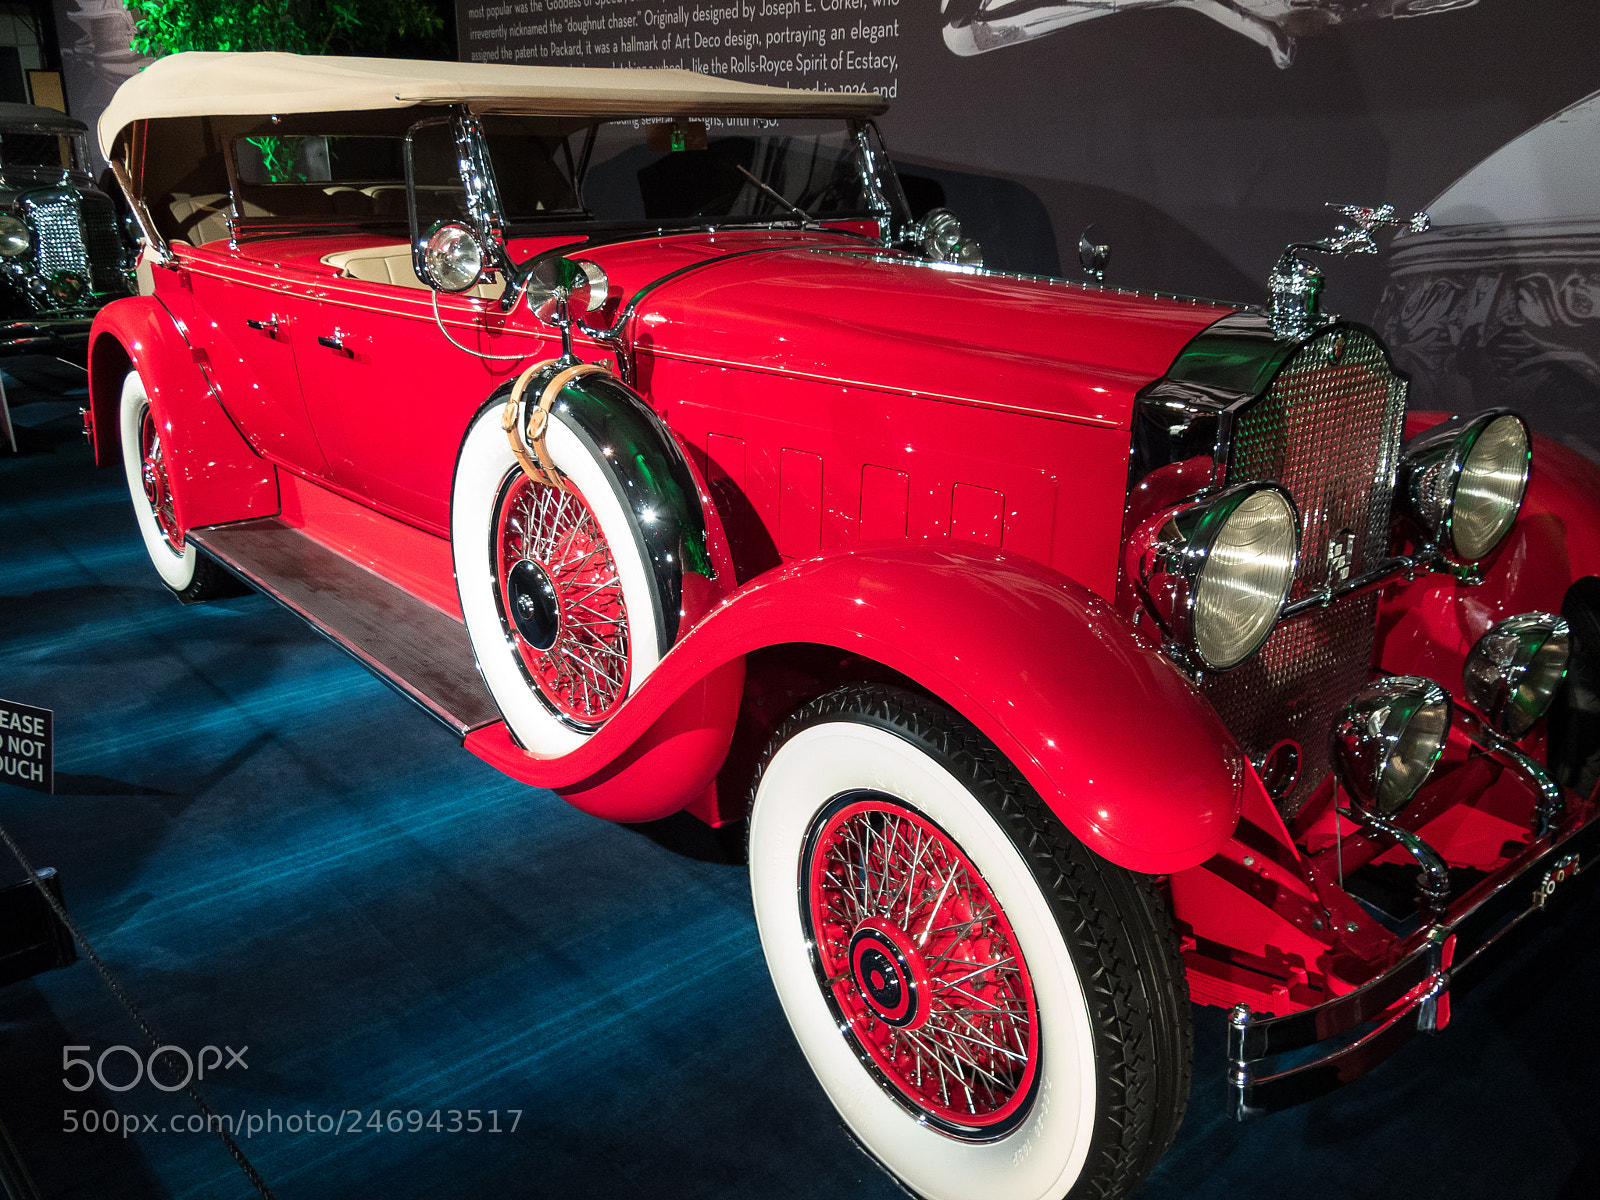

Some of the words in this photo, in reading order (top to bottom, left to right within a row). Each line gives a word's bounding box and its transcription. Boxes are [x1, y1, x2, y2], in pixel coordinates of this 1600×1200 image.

[469, 8, 485, 19] most
[486, 3, 512, 21] popular
[515, 4, 528, 14] was
[530, 0, 543, 11] the
[470, 24, 508, 41] irreverently
[509, 19, 548, 37] nicknamed
[549, 18, 563, 34] the
[564, 14, 606, 36] "doughnut
[607, 11, 642, 29] chaser."
[644, 5, 689, 30] Originally
[692, 0, 739, 25] designed
[742, 1, 756, 22] by
[759, 0, 801, 19] Joseph
[805, 0, 816, 13] E.
[471, 46, 500, 63] assigned
[501, 44, 514, 60] the
[515, 43, 538, 61] patent
[540, 43, 549, 58] to
[550, 40, 584, 57] Packard,
[585, 40, 592, 55] it
[594, 43, 610, 54] was
[613, 42, 619, 53] a
[620, 35, 659, 52] hallmark
[661, 33, 671, 50] of
[674, 33, 691, 49] Art
[694, 31, 721, 49] Deco
[724, 28, 762, 51] design,
[765, 25, 827, 50] portraying
[830, 26, 846, 41] an
[850, 18, 900, 44] elegant
[691, 57, 710, 75] like
[710, 56, 728, 74] the
[730, 53, 793, 76] Rolls-Royce
[795, 52, 828, 75] Spirit
[830, 49, 844, 71] of
[846, 50, 899, 73] Ecstacy,
[873, 78, 898, 99] and
[8, 735, 45, 760] NOT
[0, 756, 43, 783] UCH
